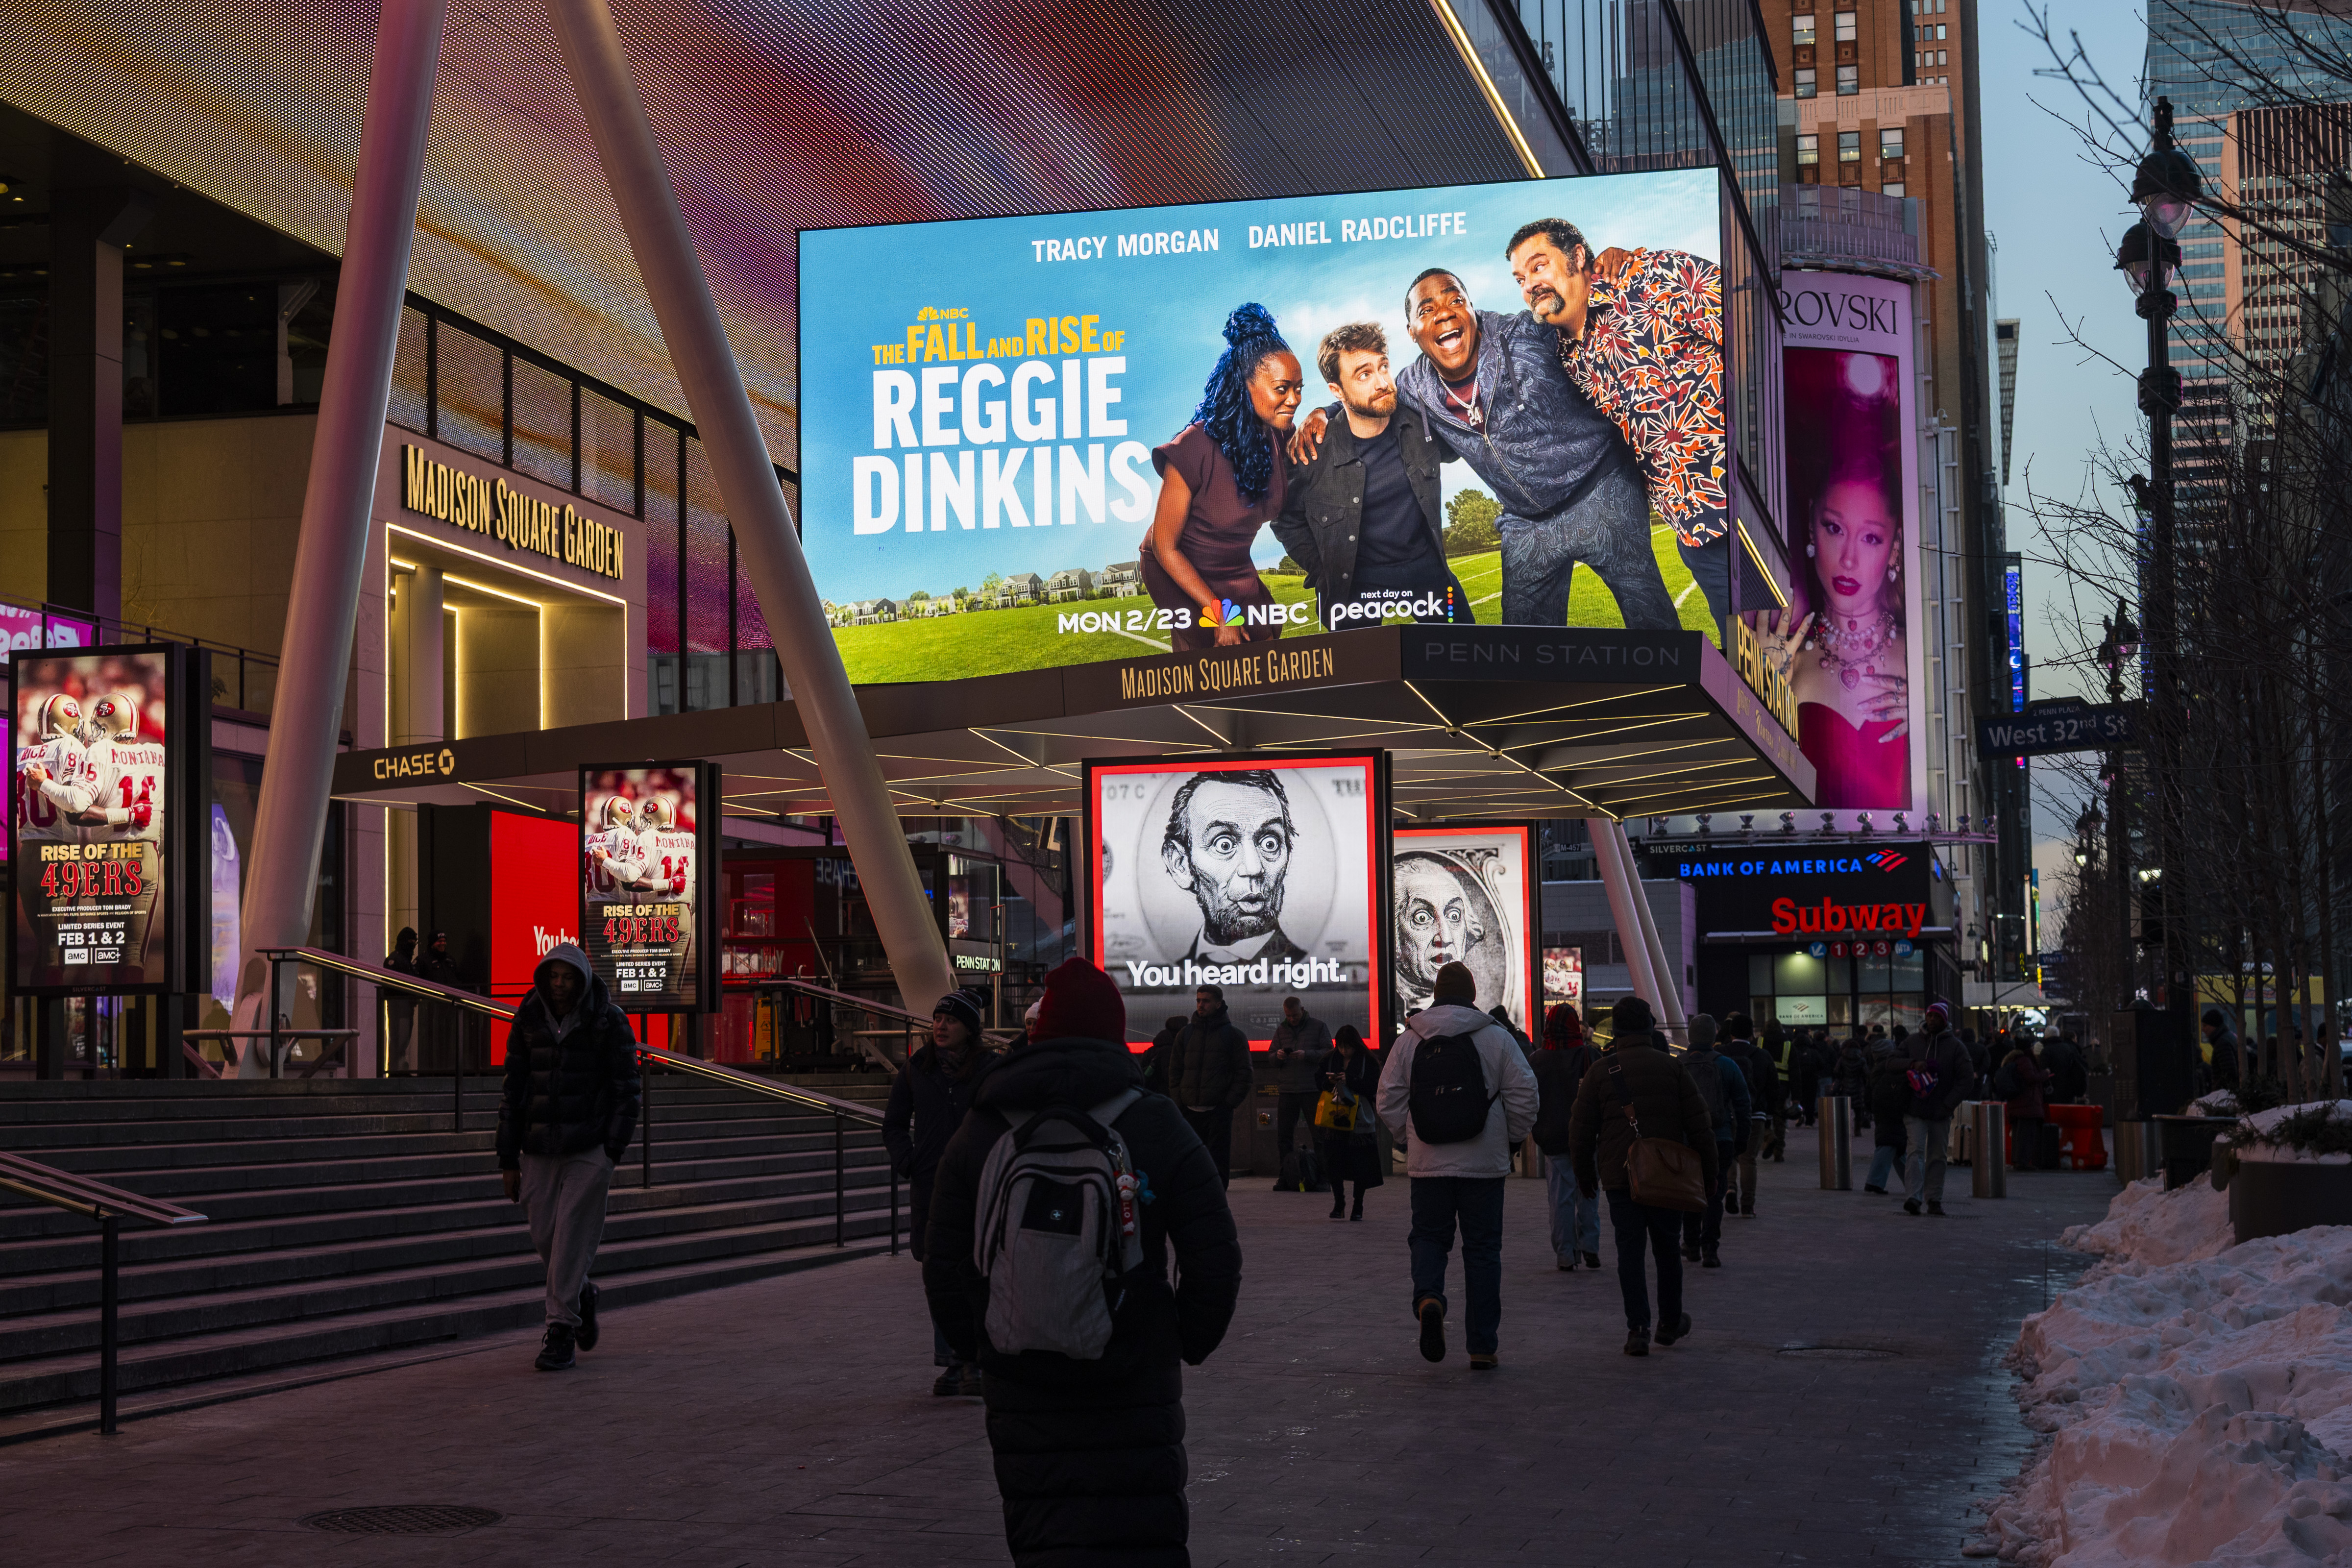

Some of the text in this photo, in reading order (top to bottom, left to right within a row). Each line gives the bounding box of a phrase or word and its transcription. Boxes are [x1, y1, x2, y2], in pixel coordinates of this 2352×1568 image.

[1249, 212, 1467, 248] DANIEL RADCLIFFE
[1032, 229, 1219, 262] TRACY MORGAN
[940, 307, 969, 319] NBC
[872, 315, 1125, 365] THE FALL AND RISE OF
[873, 356, 1127, 449] REGGIE
[853, 441, 1154, 535] DINKINS
[407, 444, 623, 580] MADISON SQUARE GARDEN
[1361, 591, 1381, 599] next
[1383, 590, 1399, 600] day
[1058, 608, 1192, 634] MON 2/23
[1248, 603, 1308, 626] NBC
[1330, 592, 1444, 631] peacock
[1425, 642, 1679, 665] PENN STATION
[1122, 647, 1333, 700] MADISON SQUARE GARDEN
[1738, 614, 1764, 701] PENN
[1766, 655, 1798, 742] STATION
[2059, 706, 2080, 714] PLAZA
[1988, 715, 2127, 747] West 32nd St
[21, 744, 48, 761] RICE
[111, 749, 165, 766] MONTANA
[374, 753, 435, 779] CHASE
[588, 833, 608, 843] RICE
[656, 836, 695, 850] MONTANA
[1650, 844, 1707, 854] SILVERCAST
[41, 843, 143, 861] RISE OF THE
[41, 860, 142, 897] 49ERS
[1680, 858, 1862, 877] BANK OF AMERICA
[603, 904, 679, 917] RISE OF THE
[1772, 896, 1926, 938] Subway
[58, 931, 125, 946] FEB 1 & 2
[603, 917, 679, 943] 49ERS
[1856, 943, 1865, 956] 2
[1877, 942, 1886, 955] 3
[616, 967, 666, 978] FEB 1 & 2
[956, 955, 1000, 971] PENN STATON
[1126, 956, 1347, 989] You heard right.
